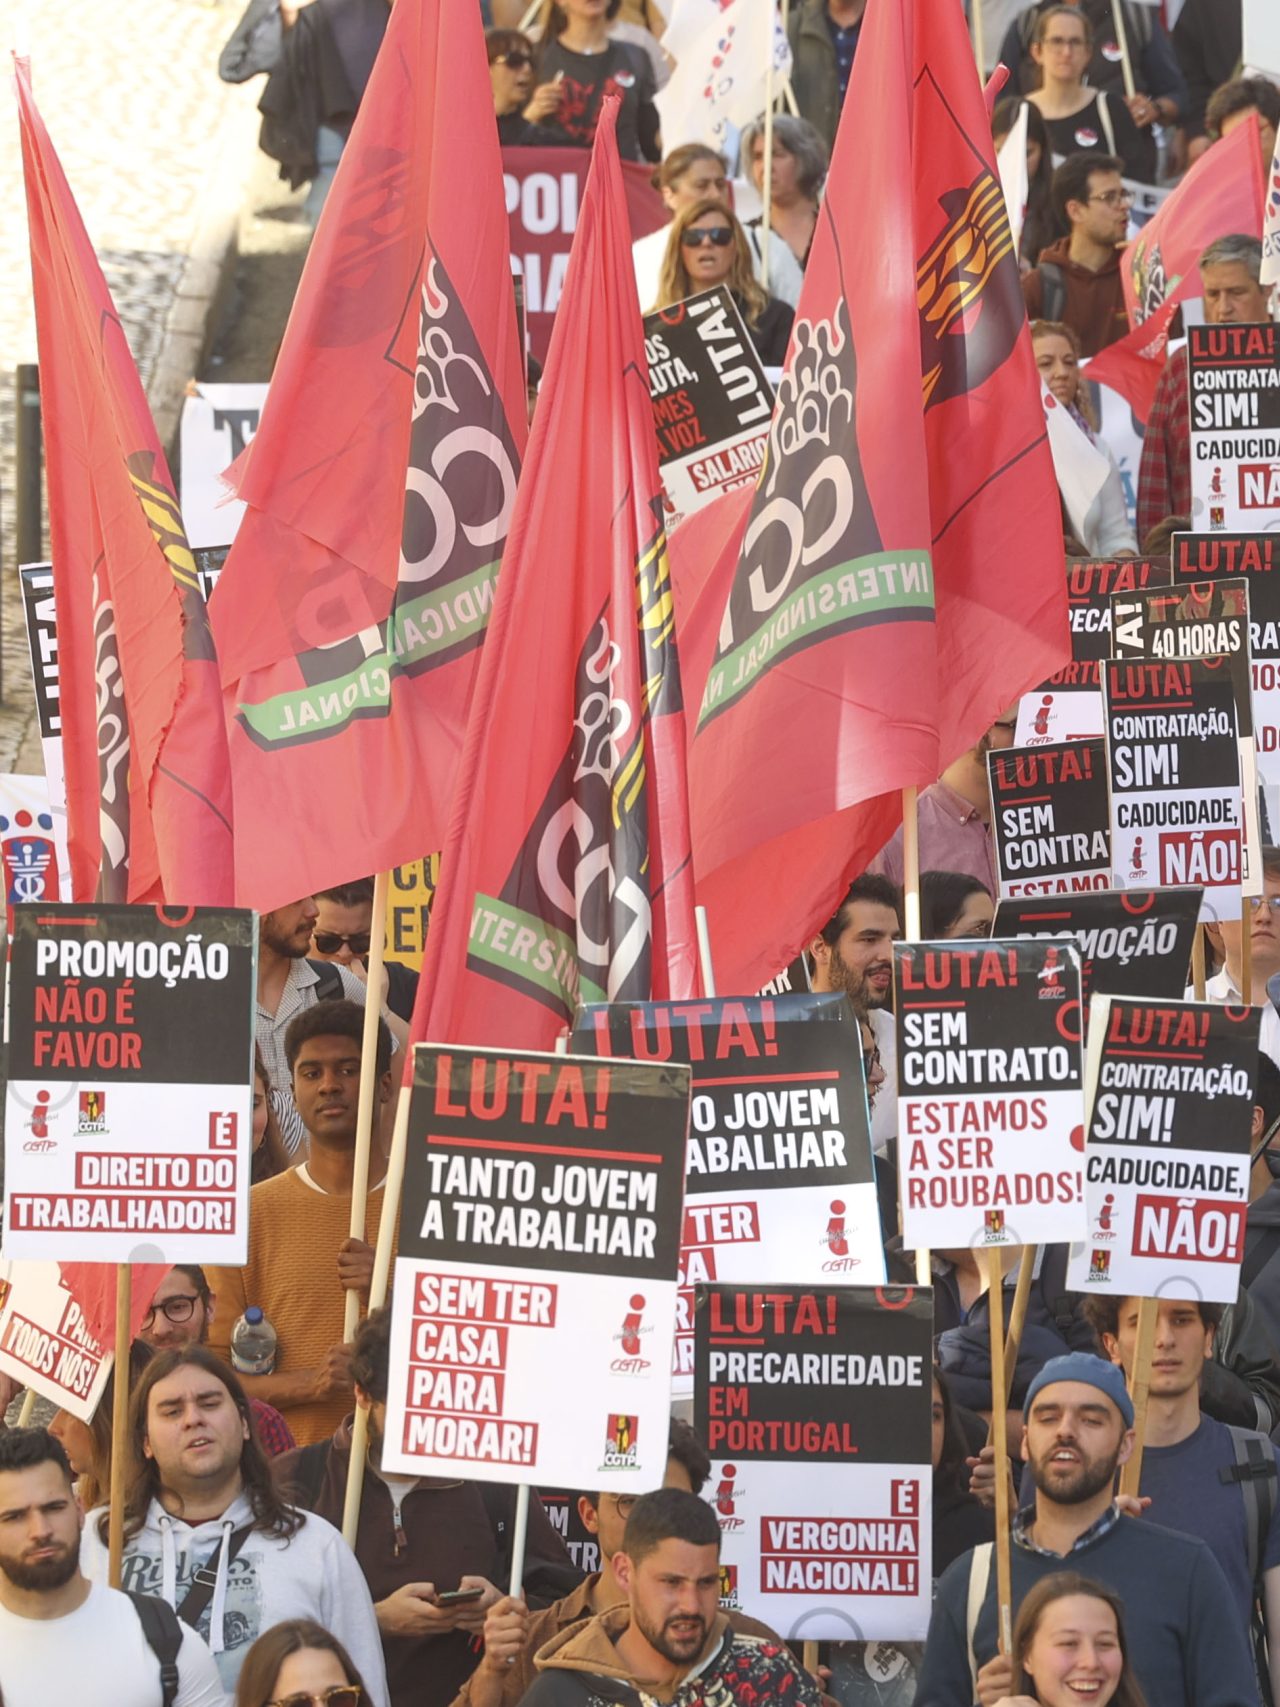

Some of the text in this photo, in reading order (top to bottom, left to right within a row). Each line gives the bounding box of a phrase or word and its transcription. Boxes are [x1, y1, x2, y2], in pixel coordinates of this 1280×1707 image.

[687, 296, 772, 426] LUTA!
[1192, 328, 1275, 357] LUTA!
[1195, 392, 1259, 428] SIM!
[1180, 541, 1273, 572] LUTA!
[1153, 620, 1241, 657] 40 HORAS
[1110, 663, 1193, 700] LUTA!
[1112, 707, 1234, 742] CONTRATAÇÃO,
[994, 748, 1093, 791] LUTA!
[1115, 743, 1179, 788] SIM!
[1002, 804, 1055, 839] SEM
[1117, 798, 1238, 829] CADUCIDADE,
[1165, 832, 1238, 885] NÃO!
[36, 934, 229, 988] PROMOÇÃO
[901, 950, 1019, 990] LUTA!
[34, 978, 136, 1025] NÃO É
[593, 1000, 778, 1062] LUTA!
[904, 1012, 967, 1047] SEM
[1107, 1007, 1211, 1047] LUTA!
[33, 1030, 143, 1069] FAVOR
[903, 1046, 1078, 1086] CONTRATO.
[433, 1055, 611, 1129] LUTA!
[1101, 1061, 1254, 1101] CONTRATAÇÃO,
[78, 1122, 106, 1133] CGTP
[724, 1087, 840, 1130] JOVEM
[906, 1098, 1048, 1134] ESTAMOS
[1093, 1093, 1176, 1143] SIM!
[215, 1116, 232, 1147] É
[81, 1156, 234, 1188] DIREITO DO
[909, 1137, 994, 1171] A SER
[426, 1153, 658, 1213] TANTO JOVEM
[908, 1171, 1083, 1209] ROUBADOS!
[1086, 1155, 1245, 1198] CADUCIDADE,
[15, 1197, 231, 1231] TRABALHADOR!
[419, 1201, 657, 1259] A TRABALHAR
[688, 1204, 754, 1241] TER
[1139, 1198, 1240, 1259] NÃO!
[418, 1275, 552, 1325] SEM TER
[709, 1292, 837, 1335] LUTA!
[7, 1316, 97, 1399] TODOS NÓS!
[415, 1323, 501, 1367] CASA
[610, 1357, 652, 1375] CGTP
[708, 1352, 923, 1387] PRECARIEDADE
[411, 1369, 498, 1413] PARA
[708, 1386, 748, 1417] EM
[407, 1415, 534, 1463] MORAR!
[708, 1420, 858, 1453] PORTUGAL
[604, 1453, 636, 1467] CGTP
[897, 1481, 914, 1514] É
[767, 1520, 916, 1553] VERGONHA
[766, 1560, 915, 1592] NACIONAL!
